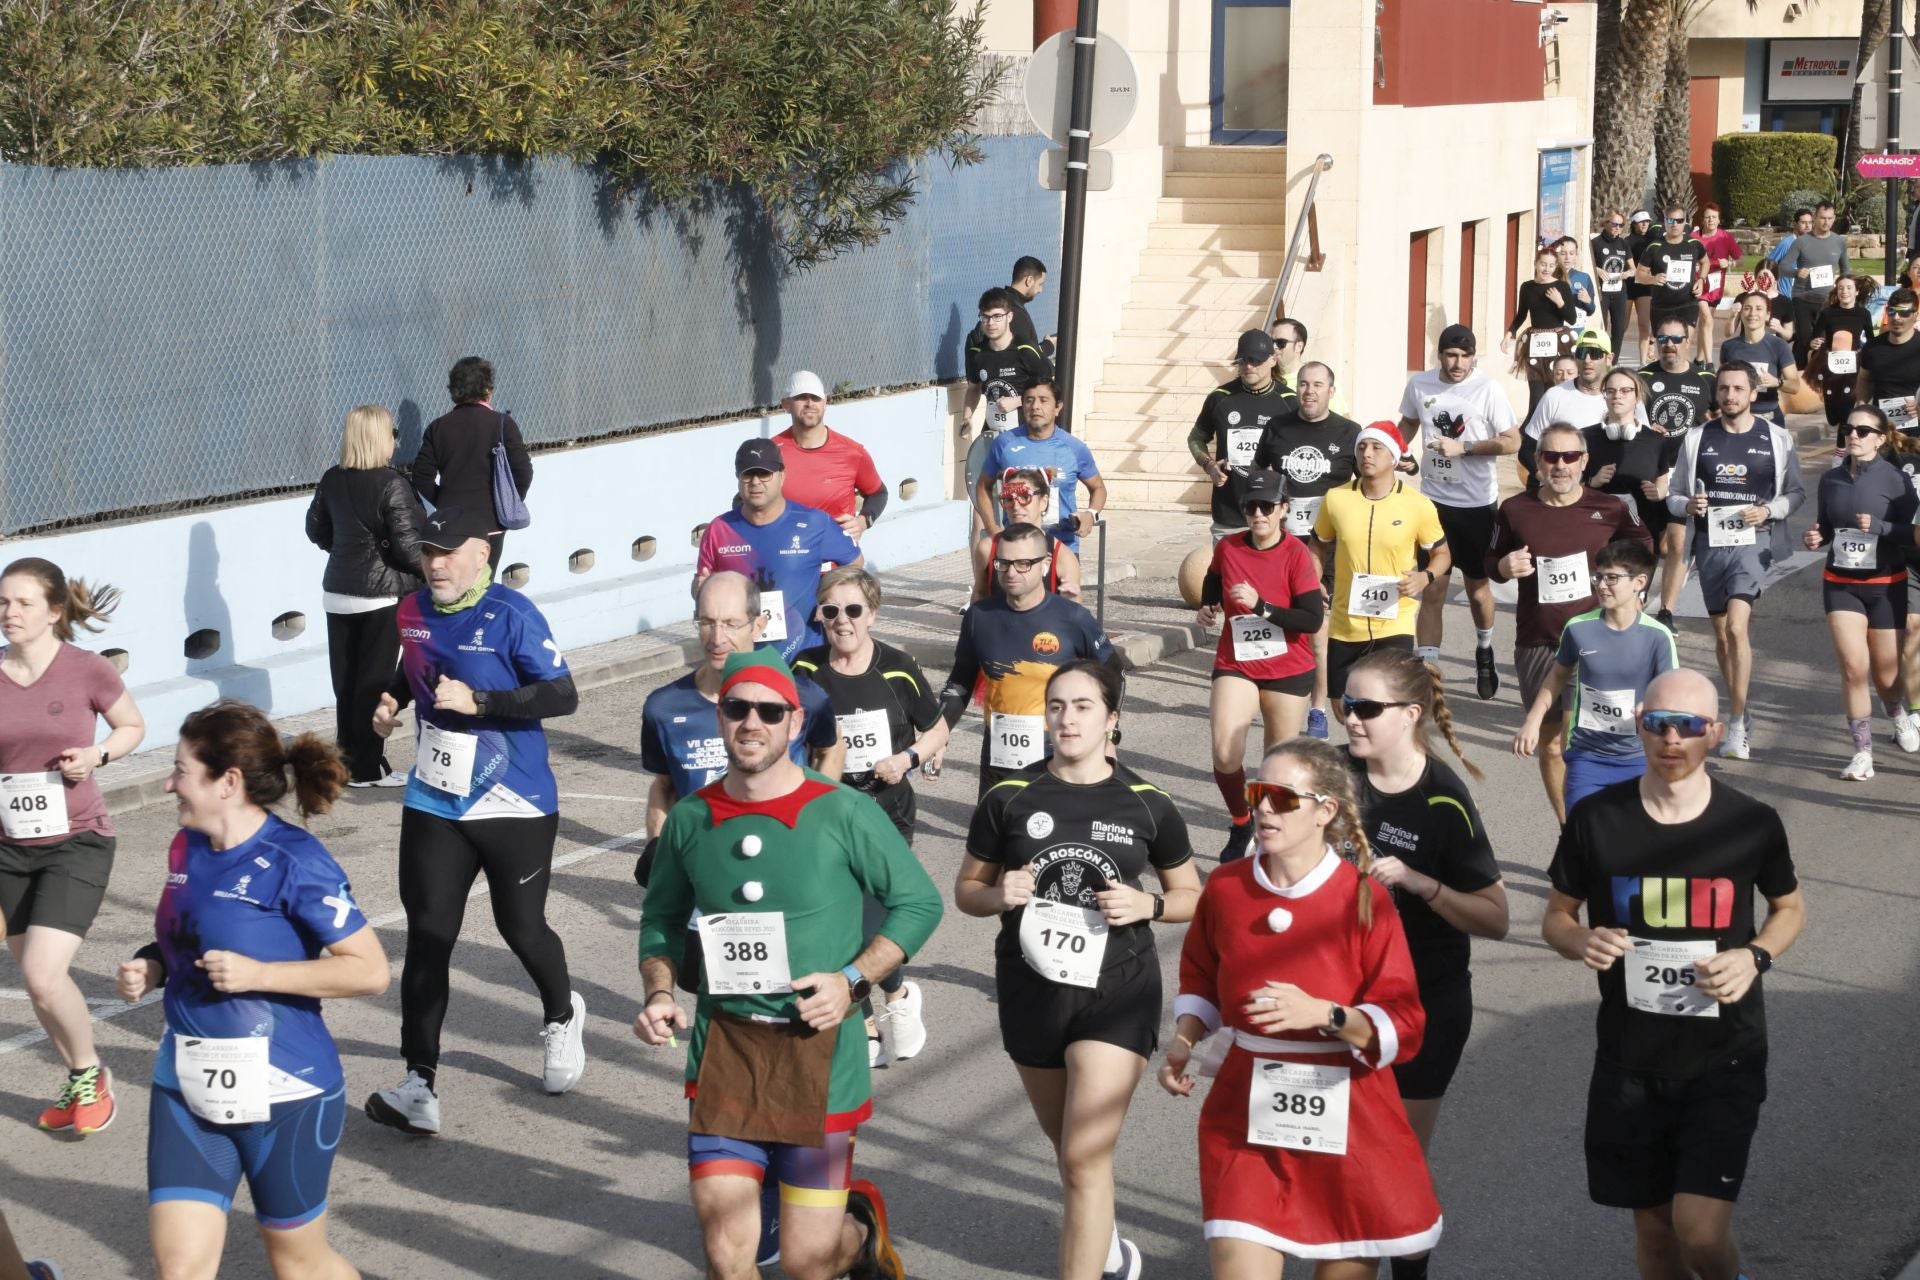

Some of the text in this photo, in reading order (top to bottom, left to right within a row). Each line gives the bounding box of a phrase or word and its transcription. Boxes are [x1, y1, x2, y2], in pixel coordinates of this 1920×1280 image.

[1794, 56, 1838, 70] METROPOL
[1861, 157, 1914, 165] MAREMOTO
[1536, 340, 1551, 348] 309
[994, 413, 1007, 422] 58
[1236, 441, 1259, 451] 420
[1431, 458, 1452, 469] 156
[1715, 464, 1748, 476] 200
[1296, 510, 1312, 521] 57
[1718, 519, 1744, 530] 133
[1841, 541, 1866, 552] 130
[1549, 571, 1577, 585] 391
[1361, 589, 1389, 602] 410
[1242, 627, 1272, 642] 226
[1592, 702, 1623, 718] 290
[686, 739, 701, 749] VII
[1000, 732, 1030, 748] 106
[431, 747, 452, 767] 78
[9, 795, 48, 812] 408
[1092, 820, 1126, 835] Marina
[1380, 821, 1413, 840] Marina
[1106, 833, 1134, 846] Dénia
[1389, 835, 1417, 852] Dénia
[1049, 847, 1103, 866] ROSCÓN
[1100, 860, 1116, 880] DE
[1611, 876, 1735, 929] run
[1040, 928, 1086, 954] 170
[723, 941, 768, 961] 388
[1644, 965, 1696, 986] 205
[203, 1068, 237, 1089] 70
[1272, 1092, 1326, 1117] 389
